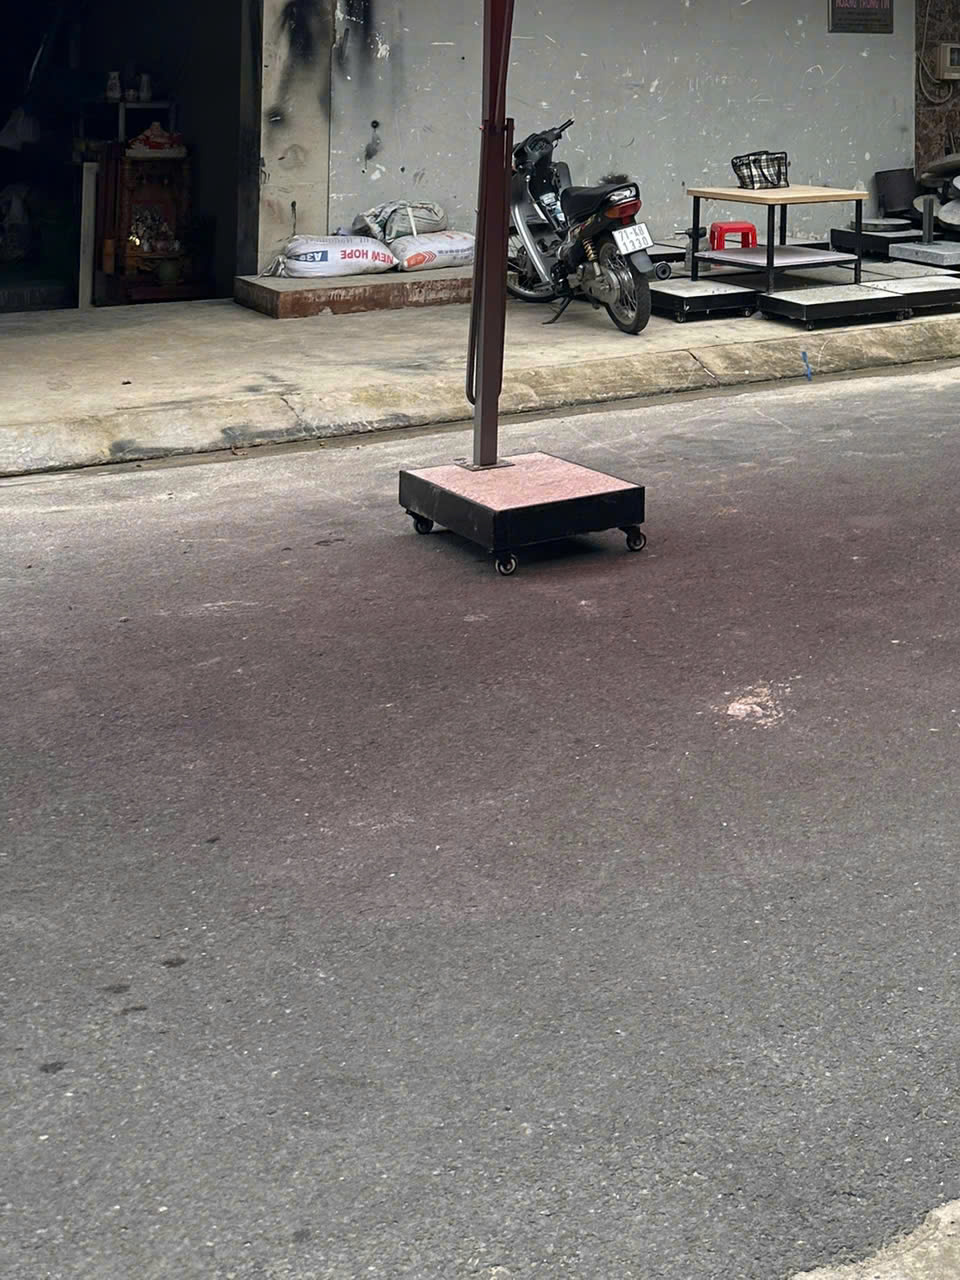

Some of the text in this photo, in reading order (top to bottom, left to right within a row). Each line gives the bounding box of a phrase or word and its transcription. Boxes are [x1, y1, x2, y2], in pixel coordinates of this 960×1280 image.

[622, 236, 649, 251] 1330
[340, 248, 369, 260] HOPE
[371, 251, 394, 265] NEW
